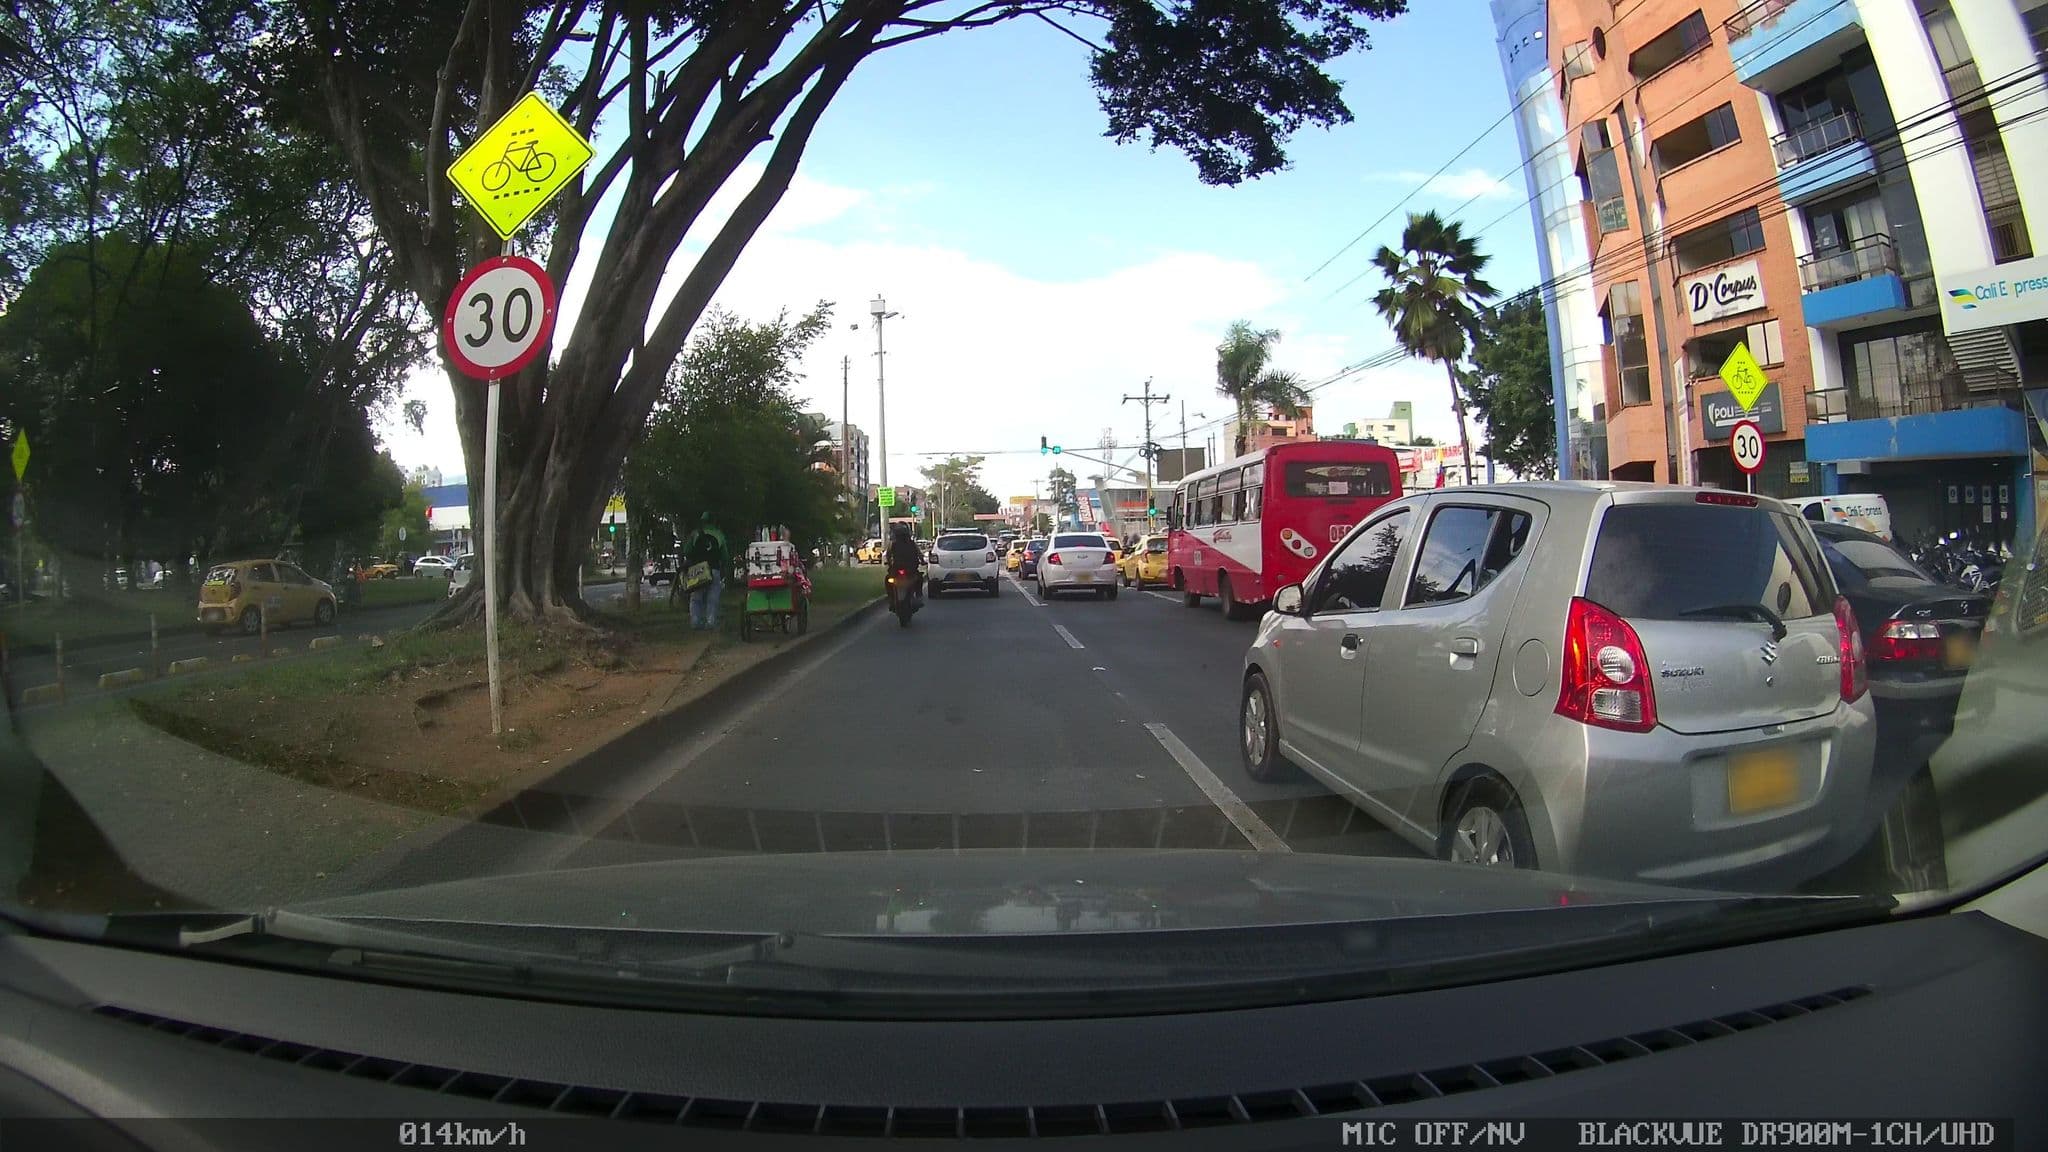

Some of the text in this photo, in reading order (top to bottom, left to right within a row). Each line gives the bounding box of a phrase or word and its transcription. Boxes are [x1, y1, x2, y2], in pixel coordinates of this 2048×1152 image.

[1689, 273, 1757, 312] D'Corpus
[1975, 283, 1998, 300] Cali
[464, 287, 533, 348] 30
[1714, 406, 1735, 419] POLI
[1737, 435, 1759, 459] 30
[1660, 666, 1705, 678] SUZUKI
